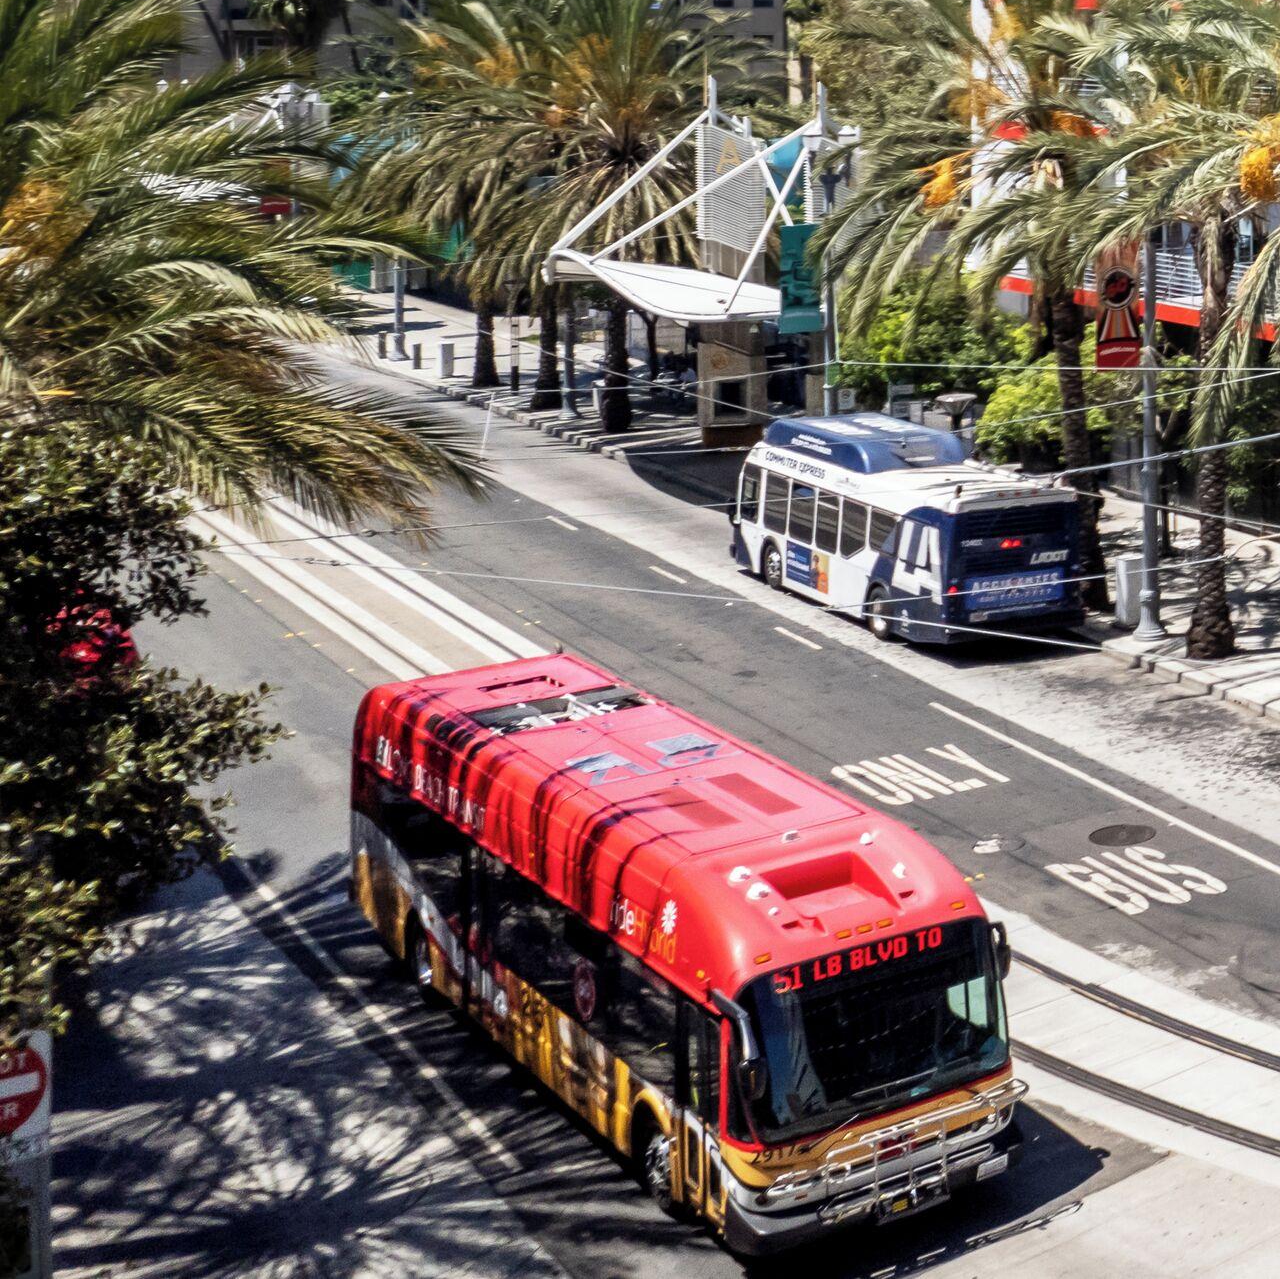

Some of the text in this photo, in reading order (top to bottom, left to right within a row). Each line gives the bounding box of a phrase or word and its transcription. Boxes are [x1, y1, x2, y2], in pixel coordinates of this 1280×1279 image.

[765, 450, 826, 480] COMMUTER EXPRESS
[891, 520, 943, 605] LA
[831, 744, 1010, 805] ONLY
[1043, 846, 1228, 915] BUS
[773, 926, 943, 994] 51 LB BLVD TO
